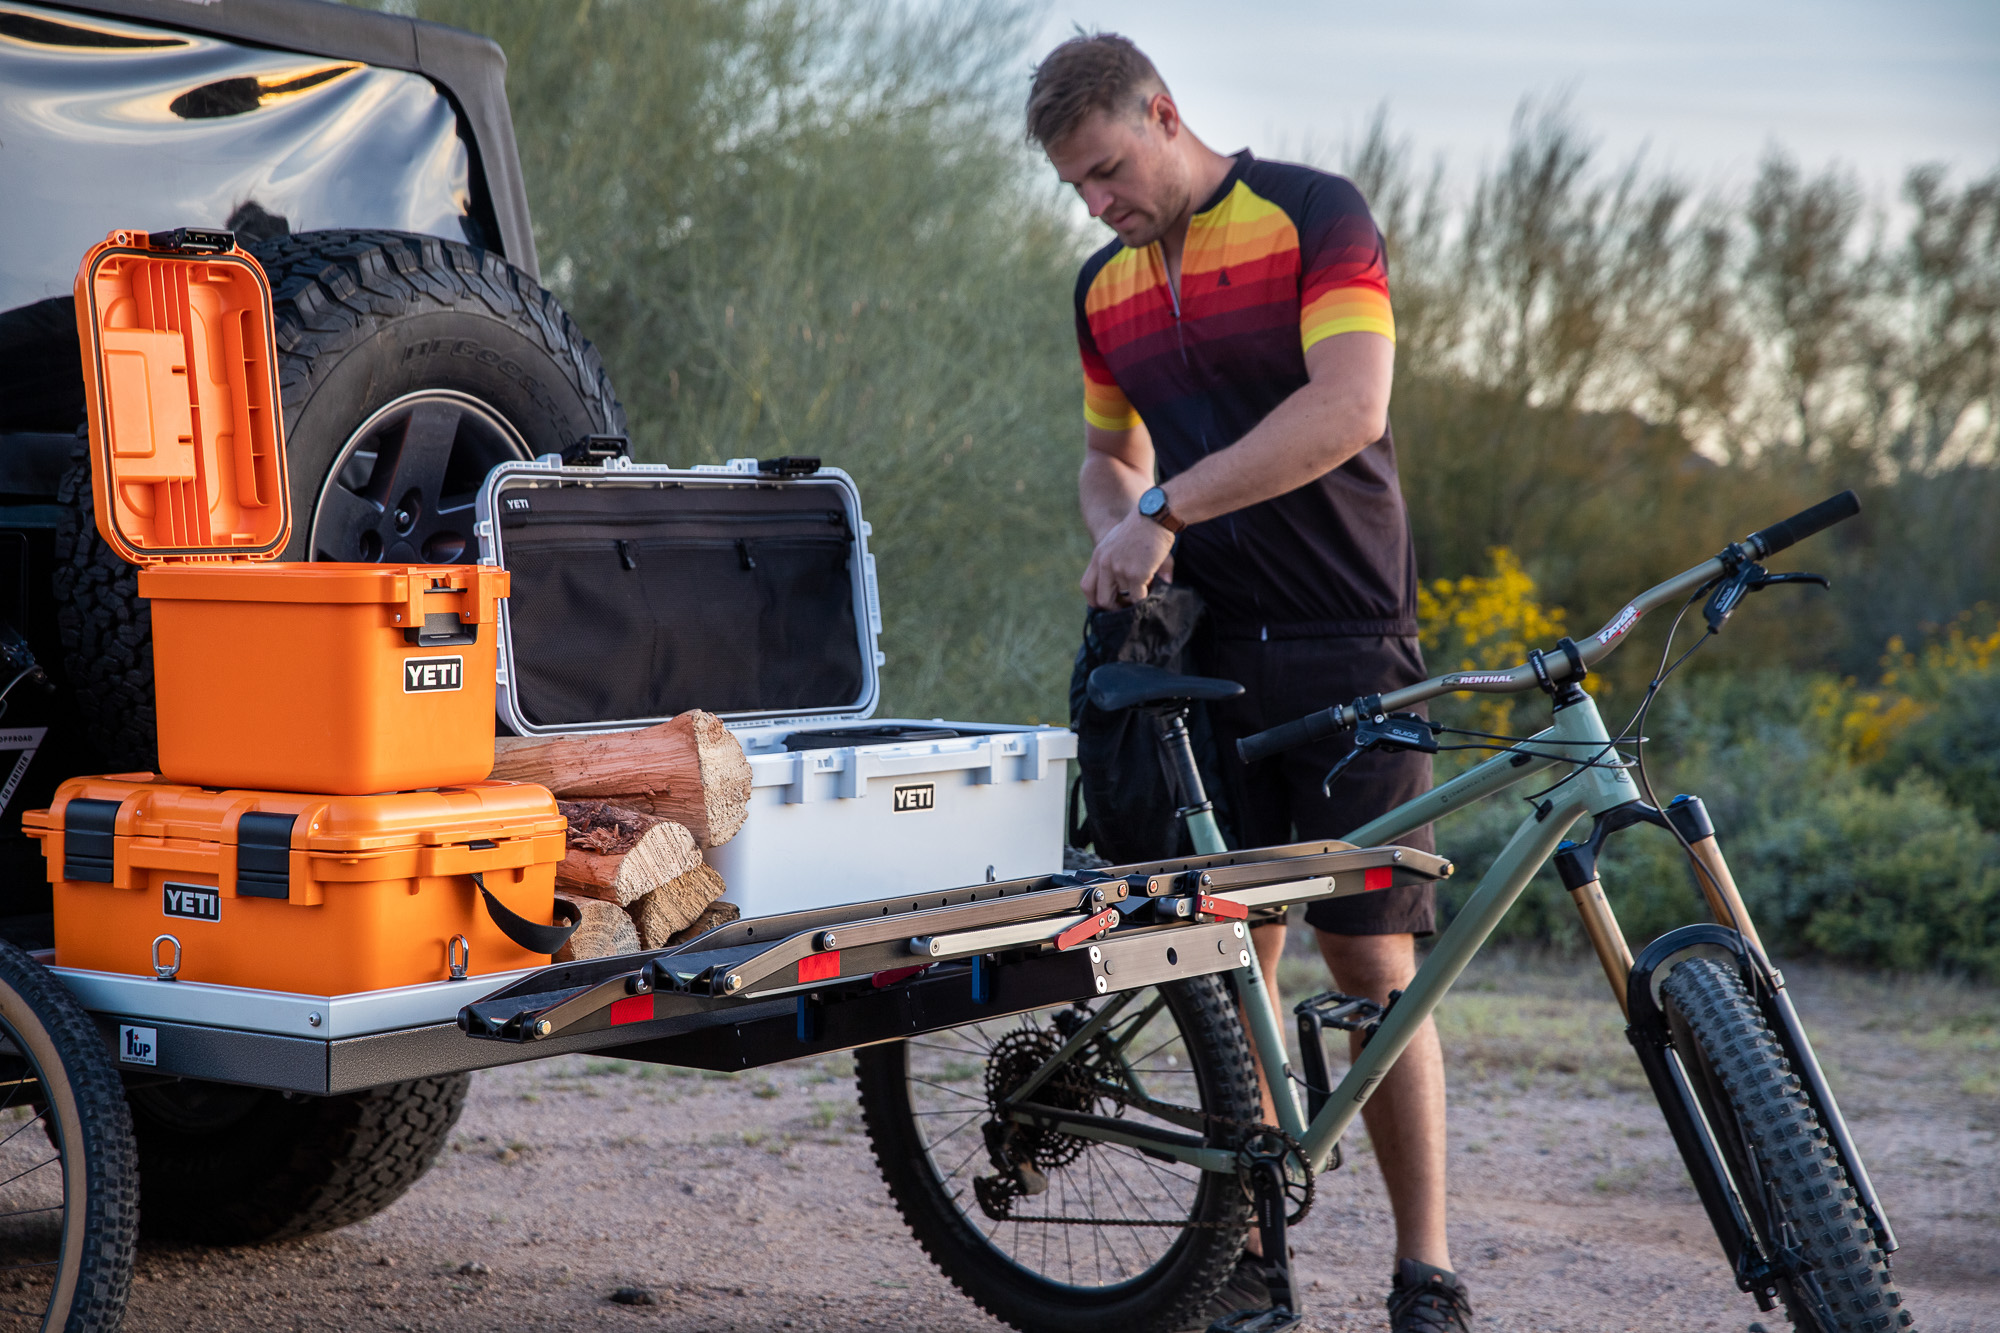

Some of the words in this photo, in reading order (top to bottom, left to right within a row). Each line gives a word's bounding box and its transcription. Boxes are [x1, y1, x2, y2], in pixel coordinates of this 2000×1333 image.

[506, 498, 529, 510] YETI
[407, 663, 459, 687] YETI
[1459, 674, 1513, 685] RENTHAL
[2, 788, 11, 800] GO
[9, 756, 29, 788] FARTHER
[895, 787, 933, 809] YETI
[166, 889, 217, 916] YETI
